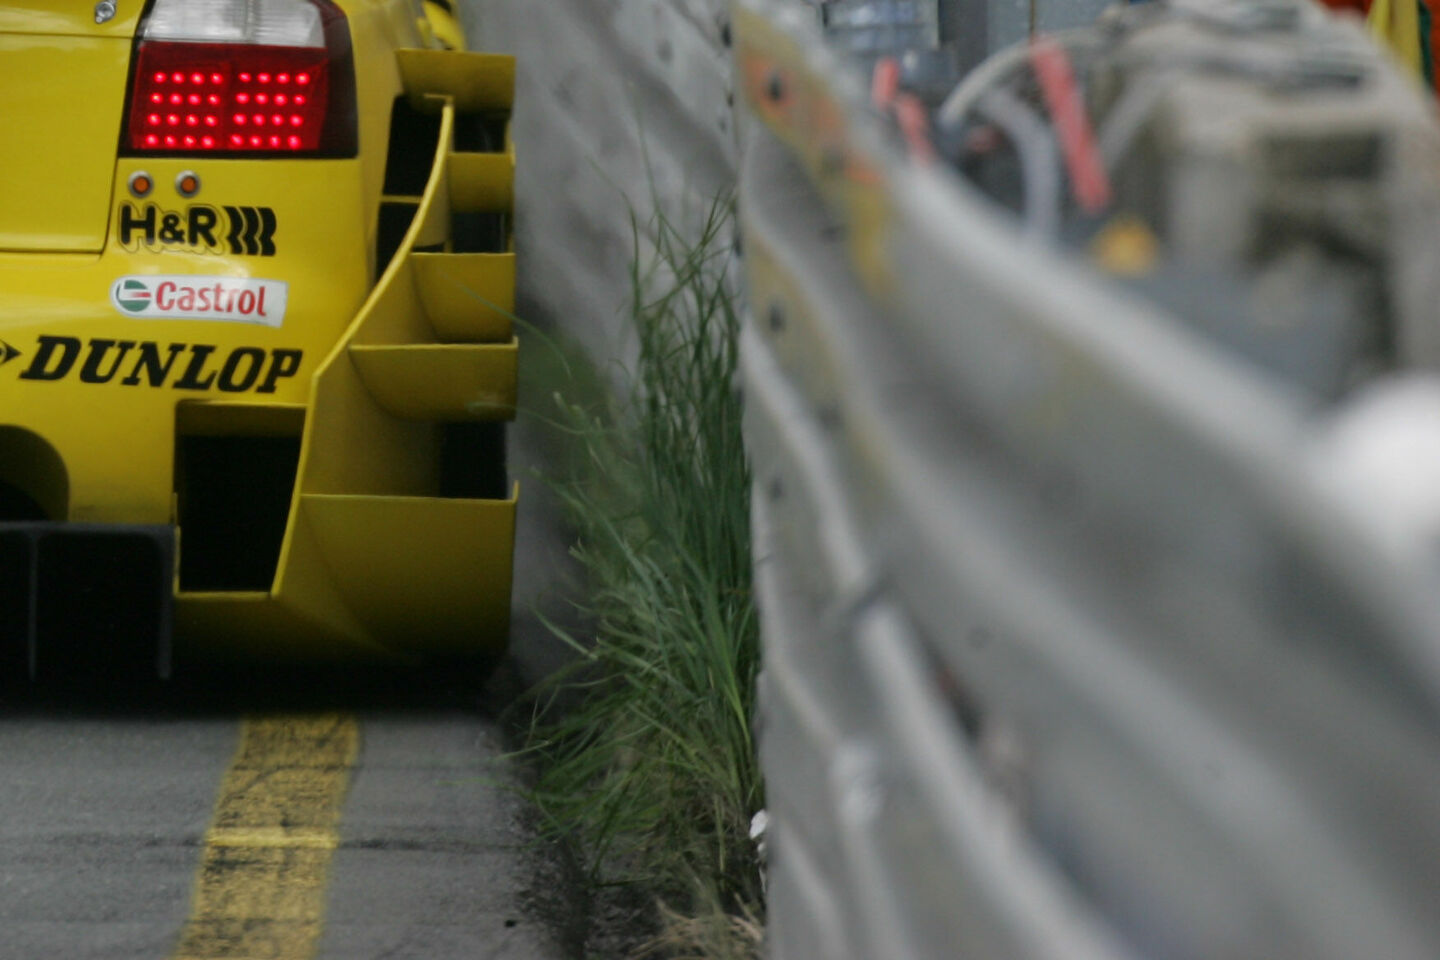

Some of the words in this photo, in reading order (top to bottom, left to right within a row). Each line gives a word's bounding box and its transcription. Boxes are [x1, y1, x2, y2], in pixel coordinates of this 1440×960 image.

[120, 204, 217, 247] H&R
[155, 281, 267, 317] Castrol
[19, 334, 303, 394] DUNLOP
